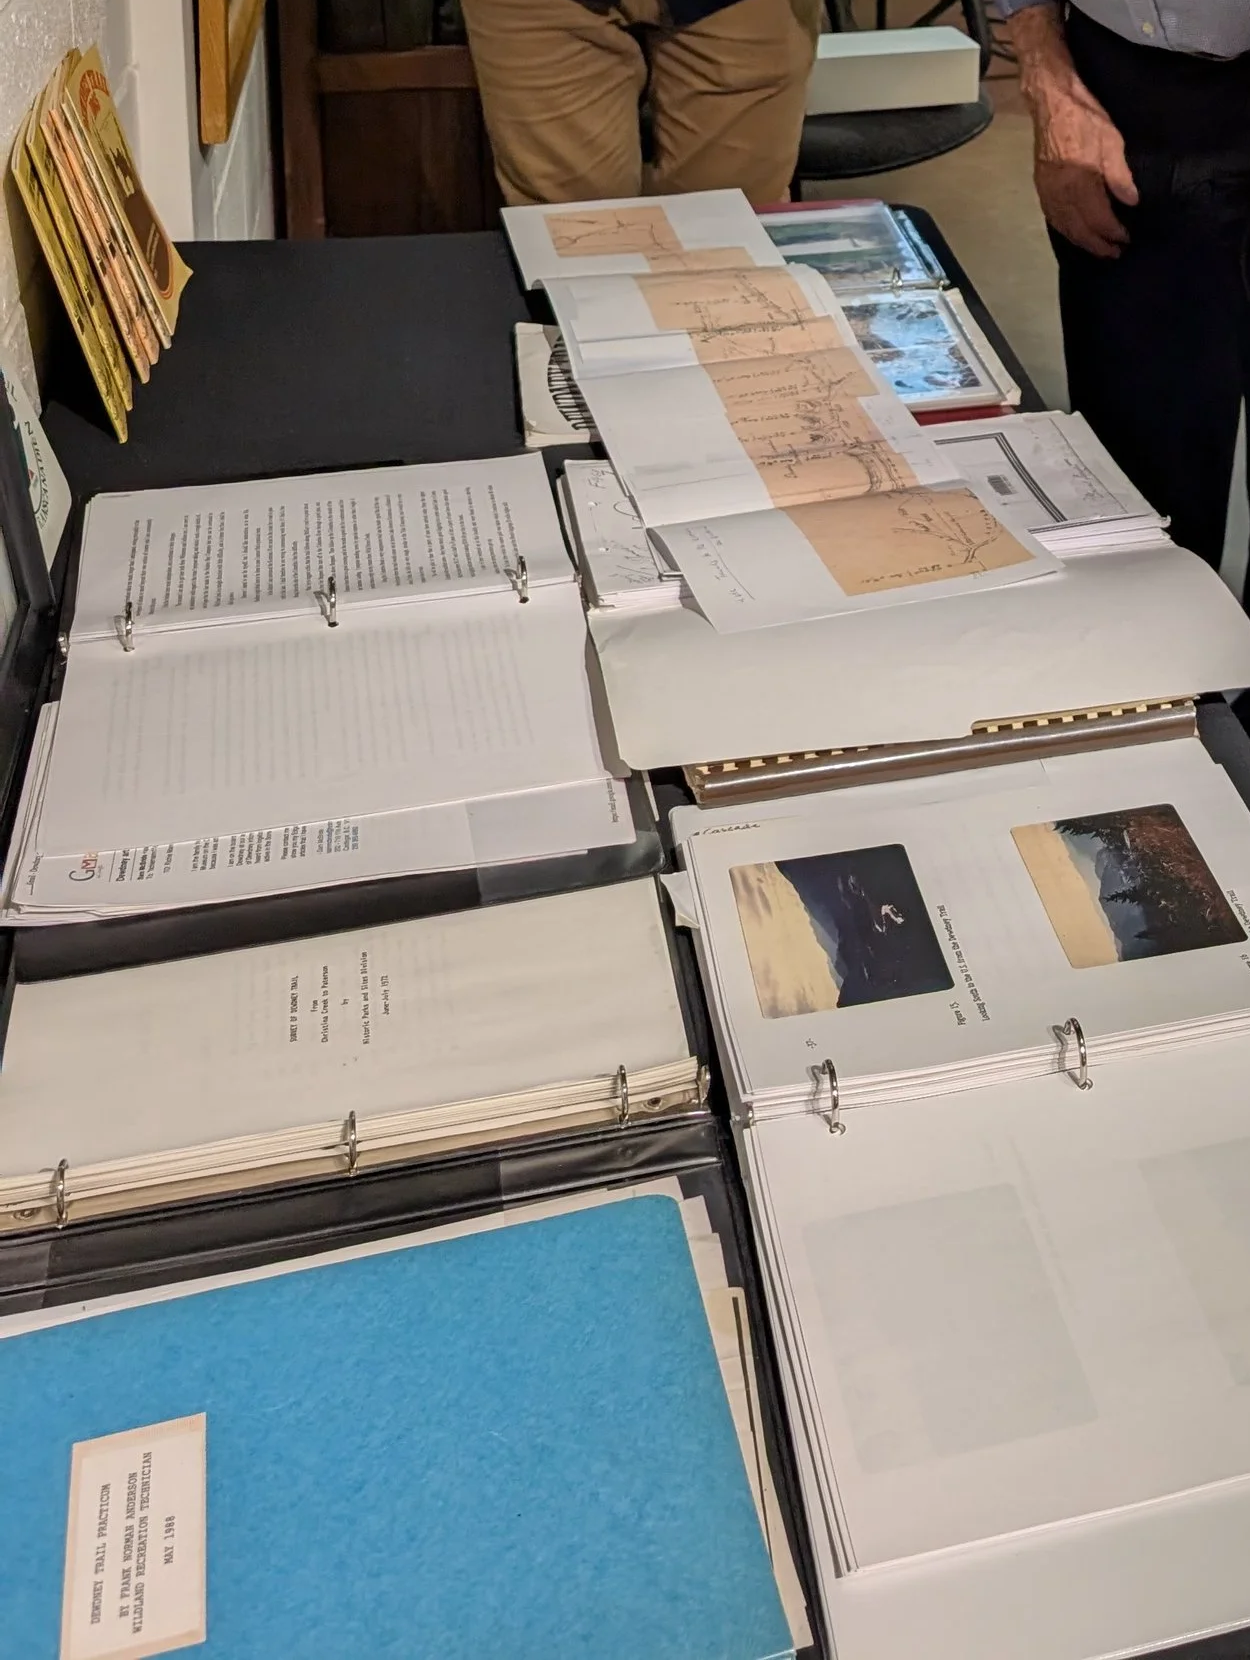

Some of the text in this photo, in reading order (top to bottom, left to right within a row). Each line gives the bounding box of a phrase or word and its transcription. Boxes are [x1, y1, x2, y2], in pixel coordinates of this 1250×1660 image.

[359, 951, 369, 975] Division
[320, 965, 330, 989] Paterson
[320, 998, 330, 1014] Creek
[361, 1003, 370, 1020] Parks
[320, 1016, 330, 1043] Christina
[118, 1472, 138, 1618] BY FRANK NORMAN ANDERSON
[131, 1451, 153, 1634] WILDLAND RECREATION TECHNICIAN
[163, 1515, 176, 1565] MAY 1988
[90, 1483, 111, 1625] DEWDNEY TRAIL PRACTICUM
